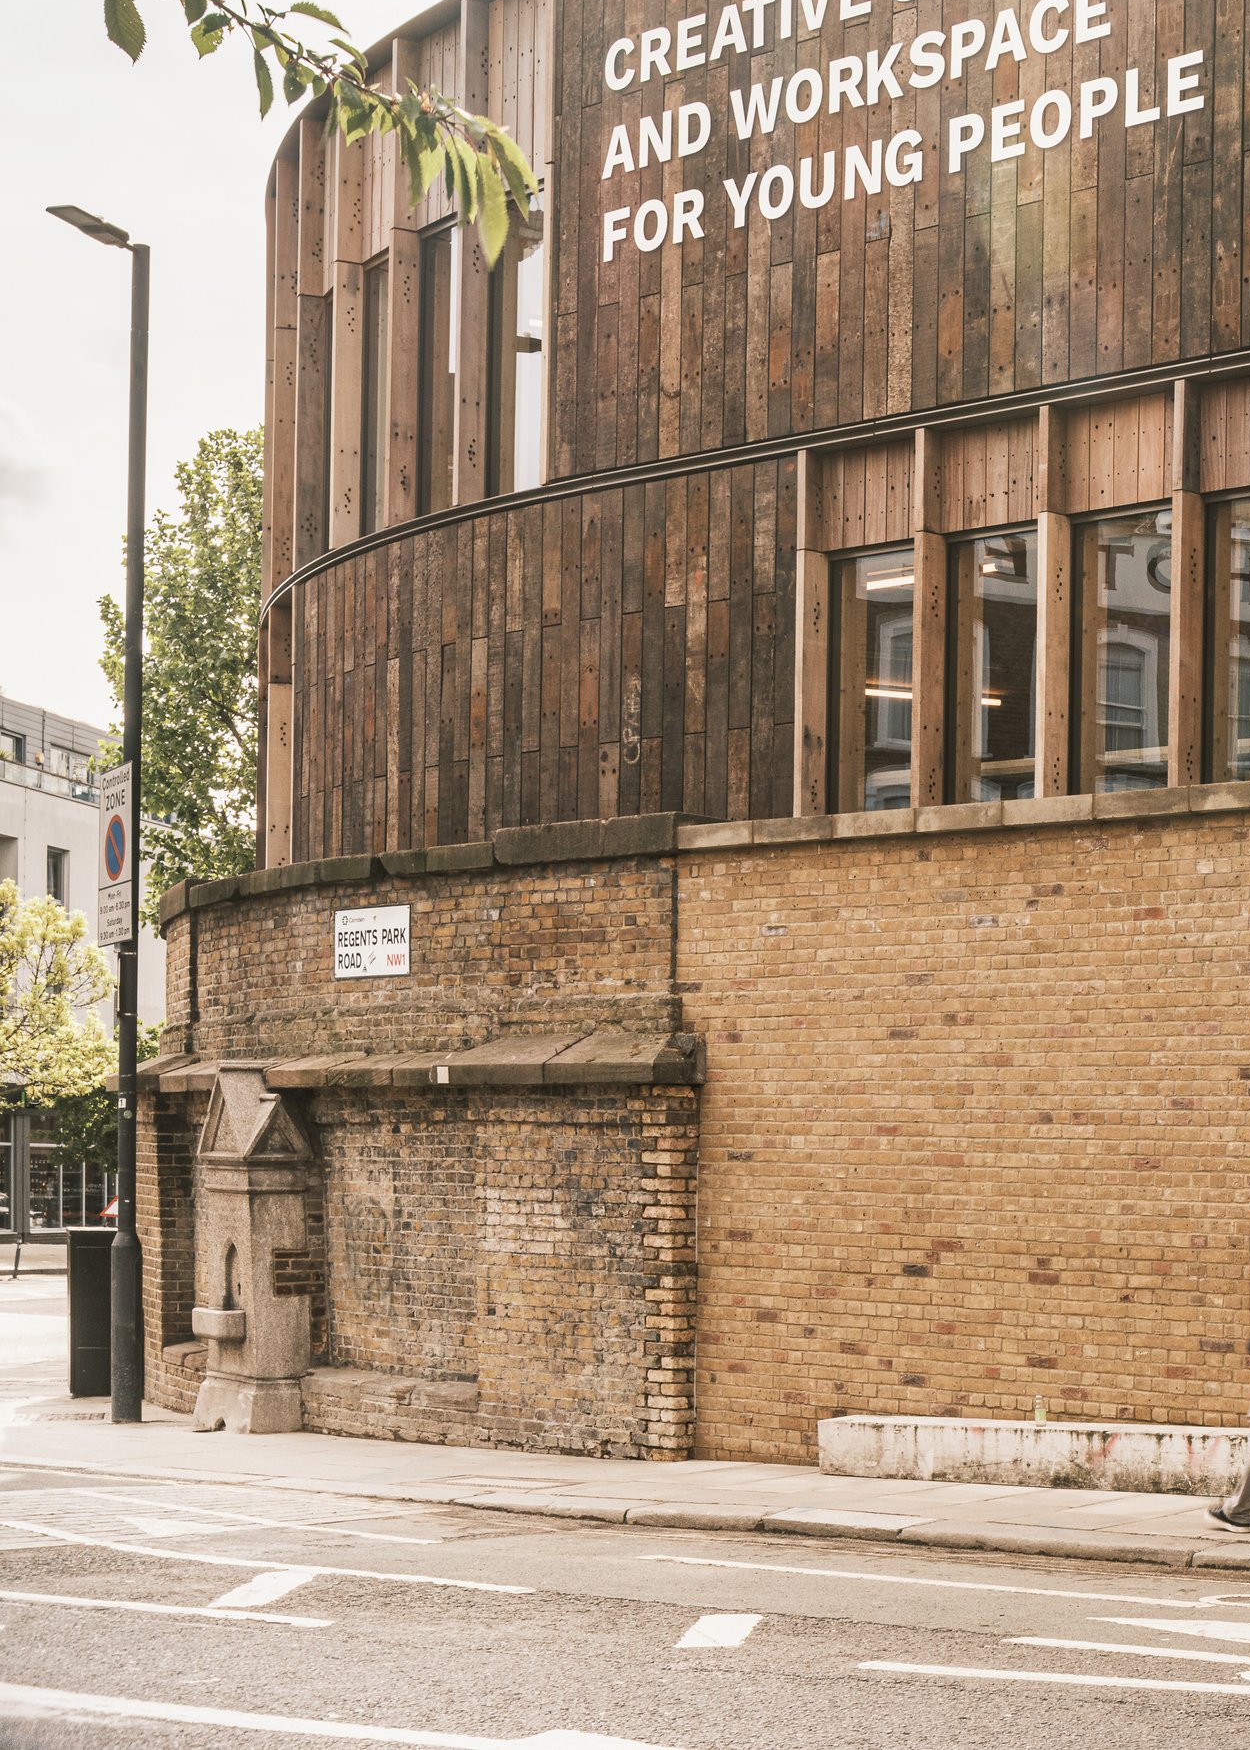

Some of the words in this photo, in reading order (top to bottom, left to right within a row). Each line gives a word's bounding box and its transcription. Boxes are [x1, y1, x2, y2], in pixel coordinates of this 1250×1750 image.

[600, 100, 712, 181] AND
[601, 189, 706, 263] FOR
[722, 129, 924, 230] YOUNG
[947, 49, 1205, 174] PEOPLE
[102, 767, 130, 791] Controlled
[105, 788, 126, 812] ZONE
[107, 917, 122, 927] Saturday
[337, 929, 378, 948] REGENTS
[381, 927, 407, 945] PARK
[337, 952, 363, 970] ROAD
[385, 953, 406, 967] NW1
